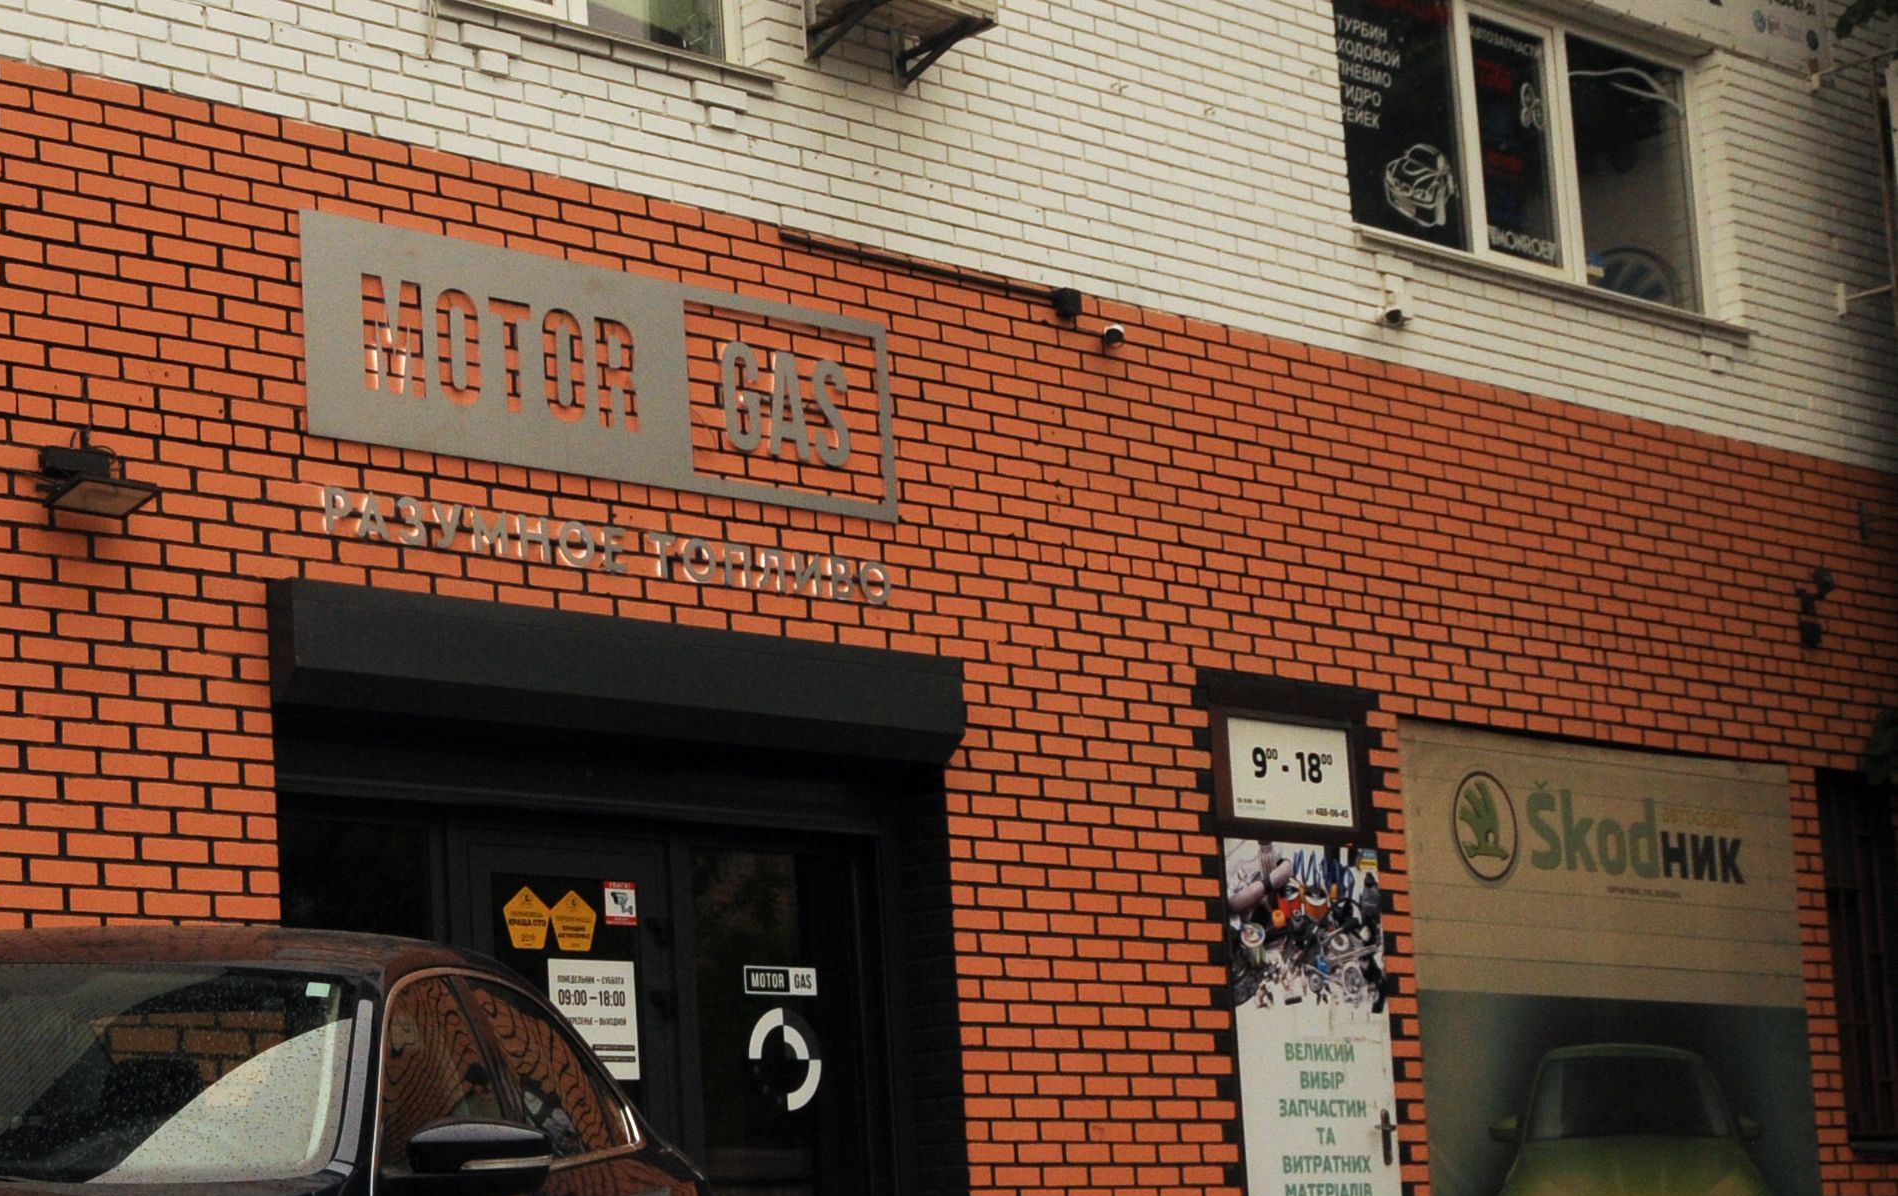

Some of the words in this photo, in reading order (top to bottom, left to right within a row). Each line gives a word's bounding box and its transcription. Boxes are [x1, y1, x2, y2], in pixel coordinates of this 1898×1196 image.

[361, 272, 641, 434] MOTOR
[722, 339, 852, 469] GAS
[322, 485, 629, 573] РАЗУМНОЕ
[649, 531, 891, 605] ТОПЛИВО
[751, 972, 784, 988] MOTOR
[794, 973, 812, 989] GAS
[558, 989, 587, 1006] 09:00
[599, 990, 626, 1007] 18:00
[1284, 1040, 1355, 1062] ВЕЛИКИЙ
[1300, 1071, 1344, 1090] ВИБІР
[1279, 1098, 1367, 1118] ЗАПЧАСТИН
[1316, 1127, 1336, 1145] ТА
[1282, 1155, 1371, 1174] ВИТРАТНИХ
